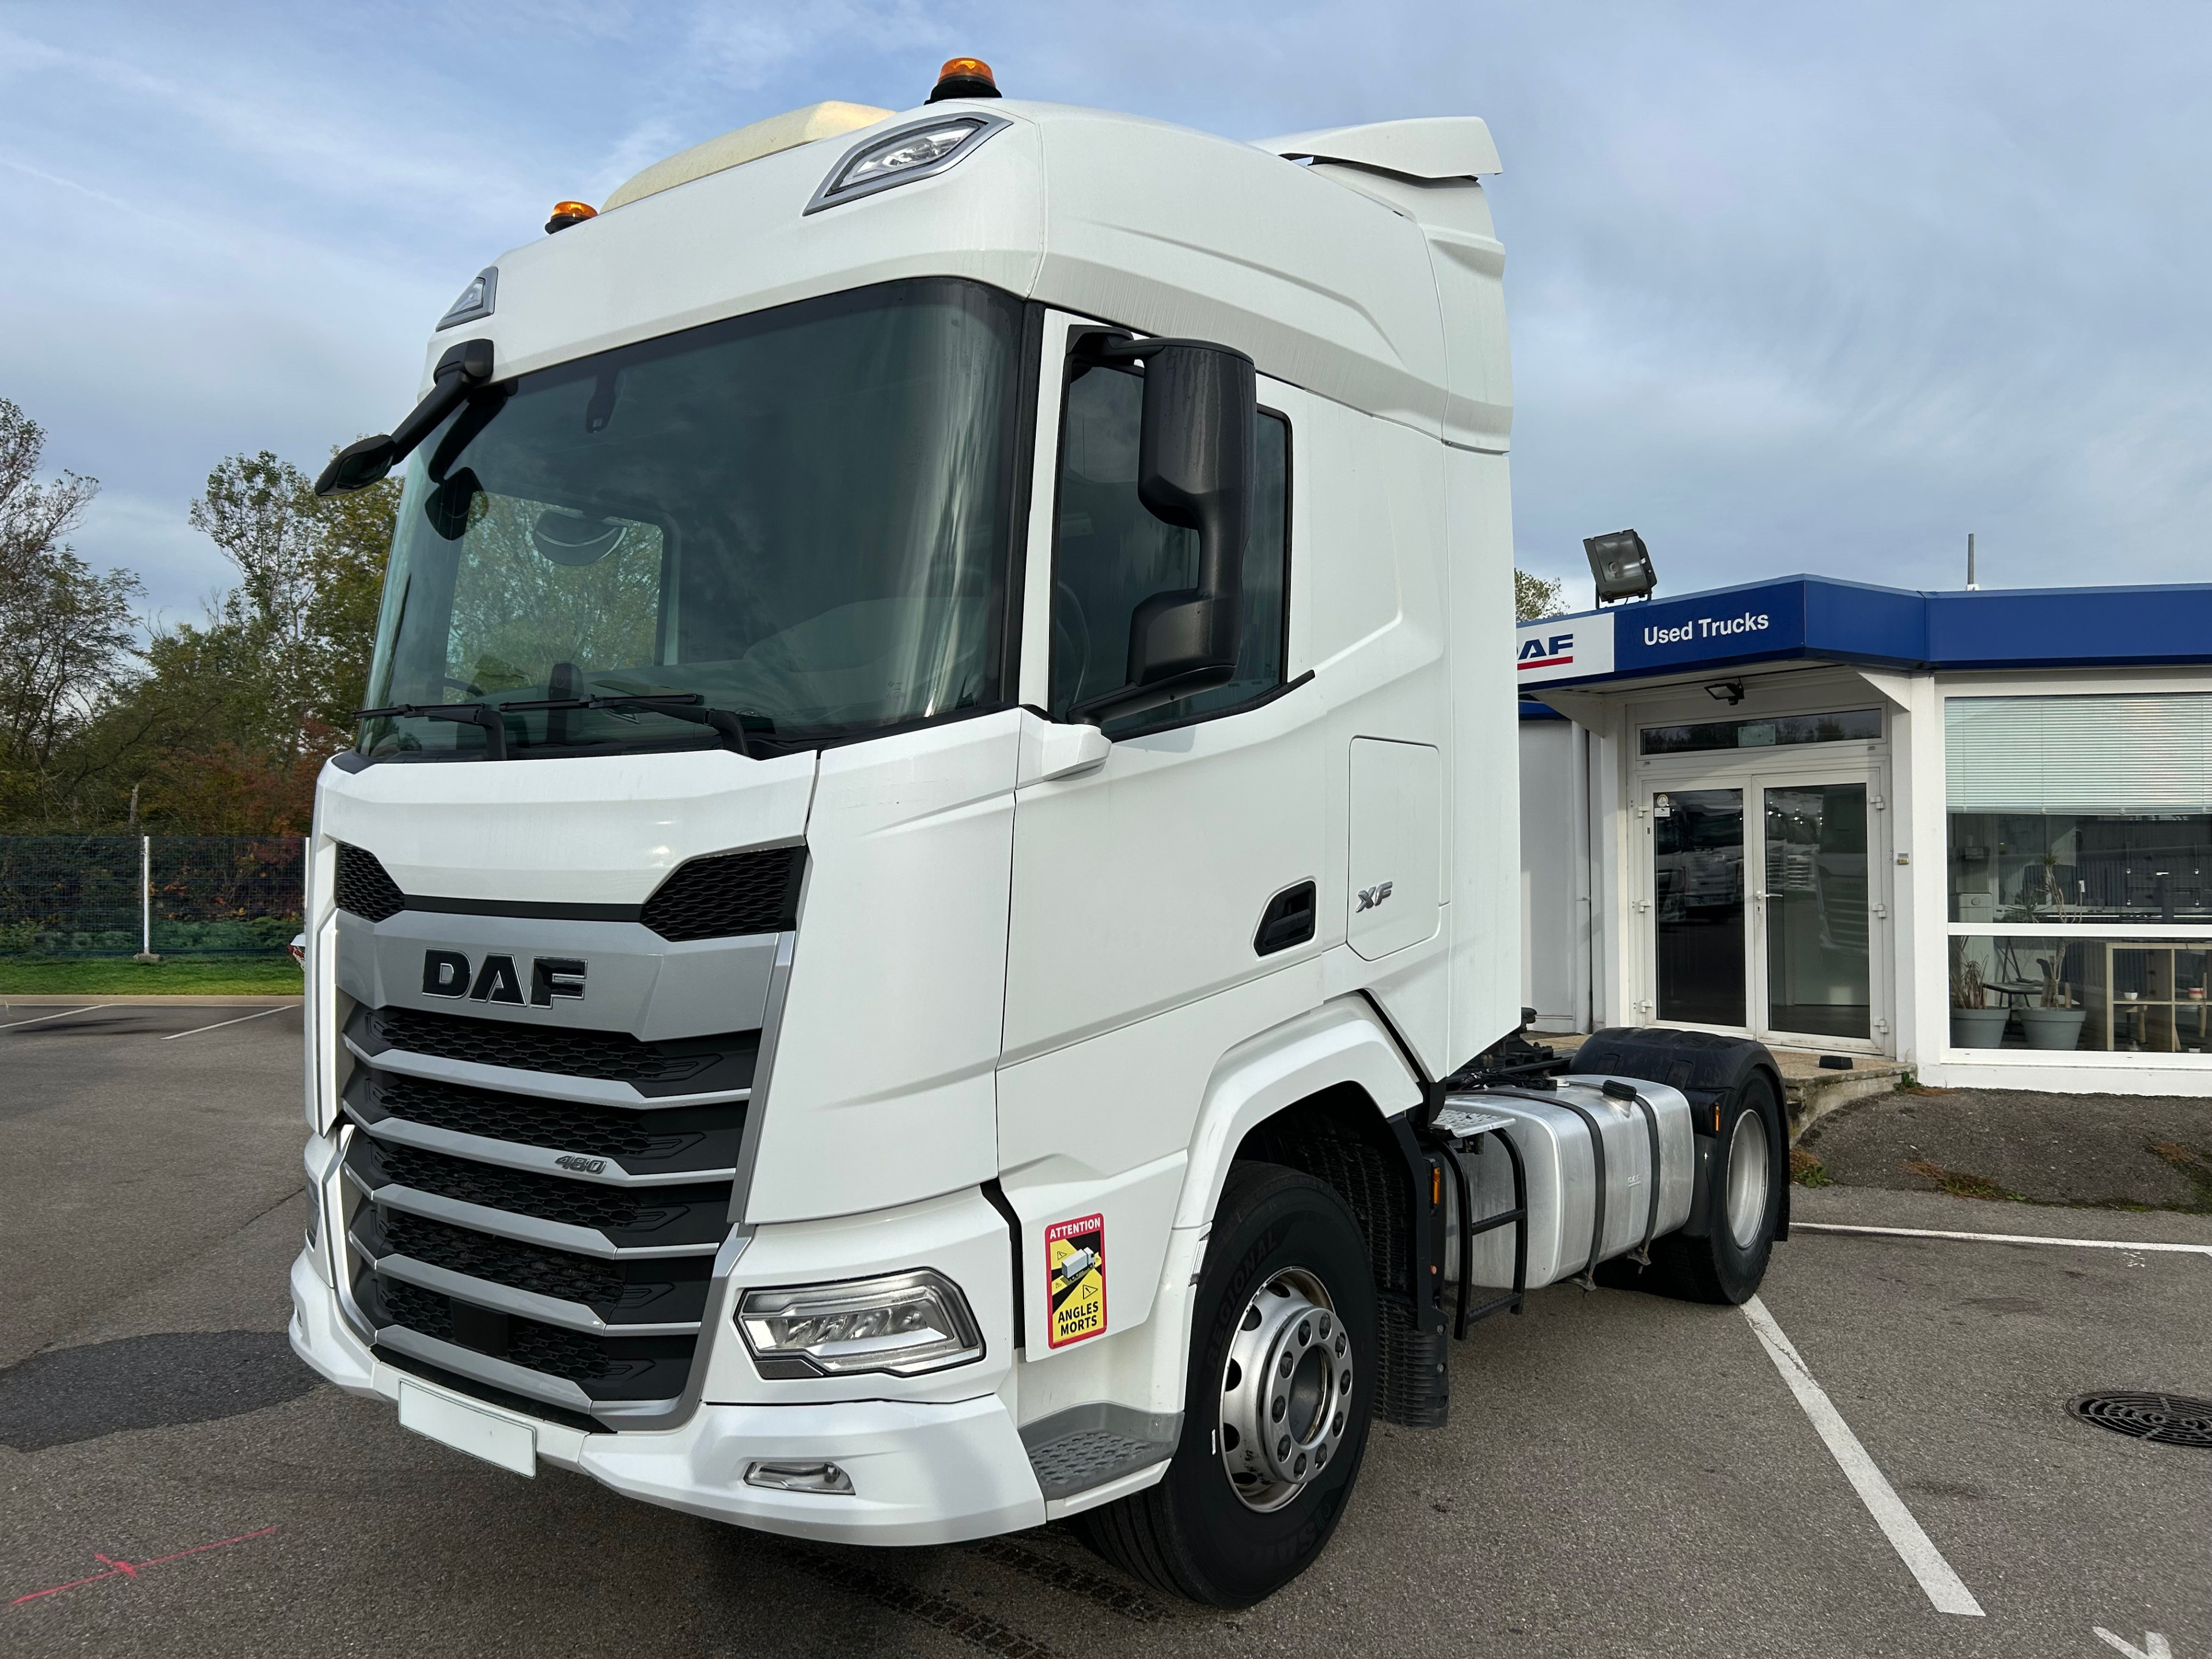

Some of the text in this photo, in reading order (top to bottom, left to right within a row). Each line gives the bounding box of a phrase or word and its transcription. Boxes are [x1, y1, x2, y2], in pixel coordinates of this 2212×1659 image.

[1644, 612, 1769, 646] Used Trucks
[1516, 634, 1573, 660] AF
[1355, 881, 1393, 913] XF
[422, 948, 588, 1009] DAF
[555, 1155, 607, 1174] 480
[1050, 1217, 1101, 1240] ATTENTION
[1058, 1301, 1099, 1324] ANGLES
[1060, 1315, 1097, 1336] MORTS
